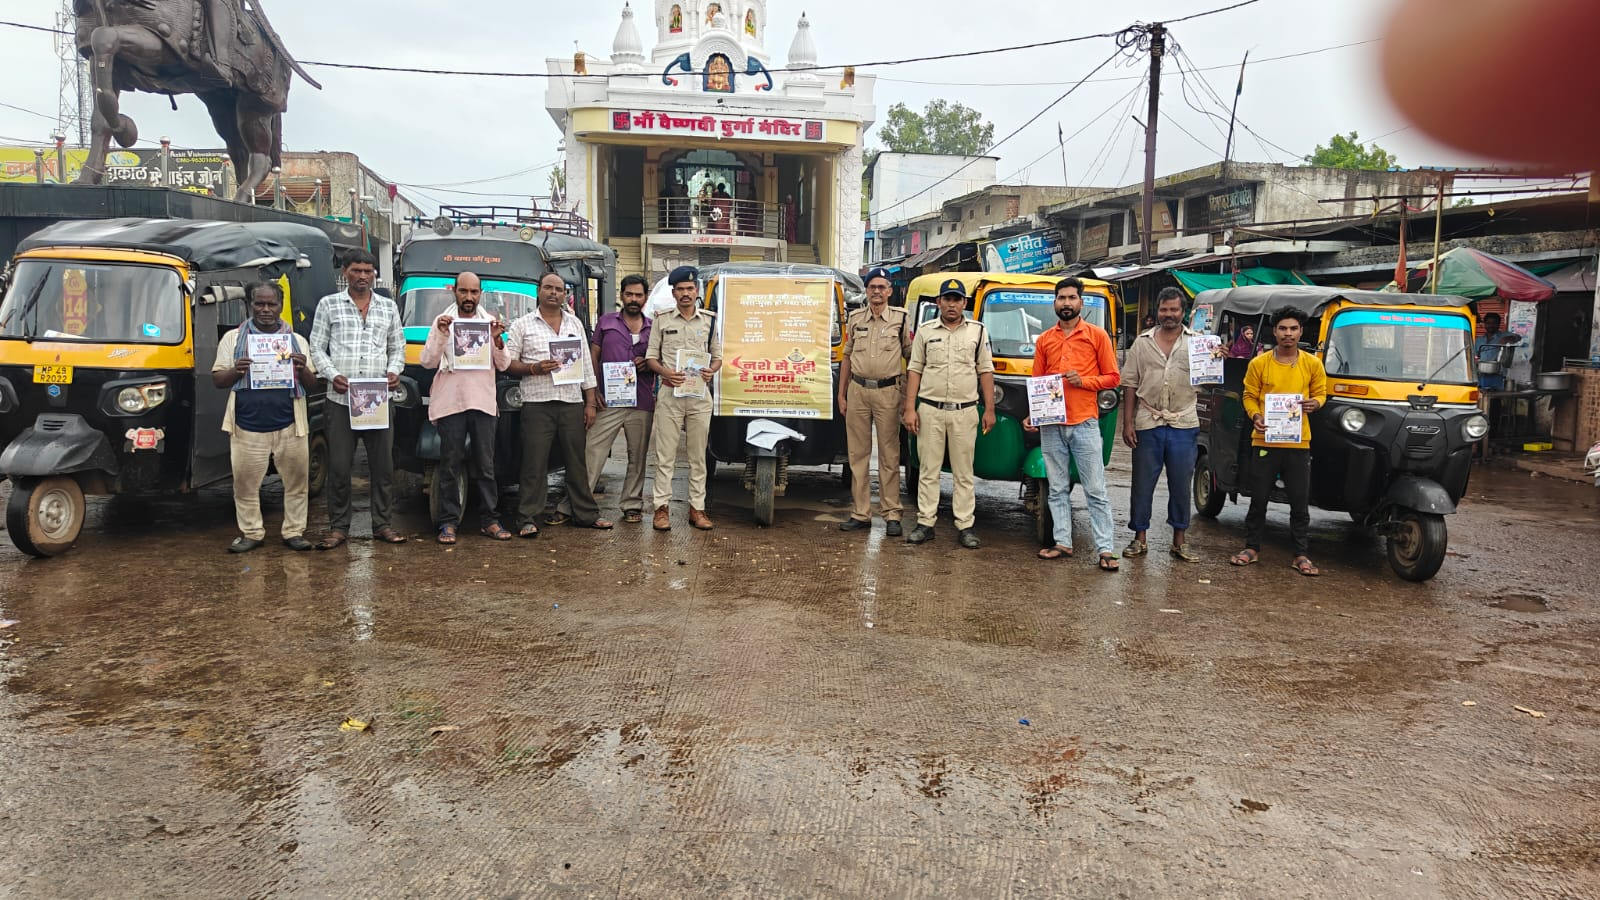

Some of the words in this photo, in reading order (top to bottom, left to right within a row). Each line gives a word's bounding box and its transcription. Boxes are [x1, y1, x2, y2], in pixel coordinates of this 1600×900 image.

[659, 113, 717, 132] वैष्णवी
[721, 117, 755, 136] दुर्गा
[759, 119, 802, 135] मंदिर
[66, 298, 84, 317] 14
[42, 366, 53, 375] MP
[56, 366, 67, 374] 49
[743, 359, 771, 370] नशे
[775, 360, 789, 370] से
[792, 360, 816, 375] दूरी
[40, 374, 68, 383] R2022
